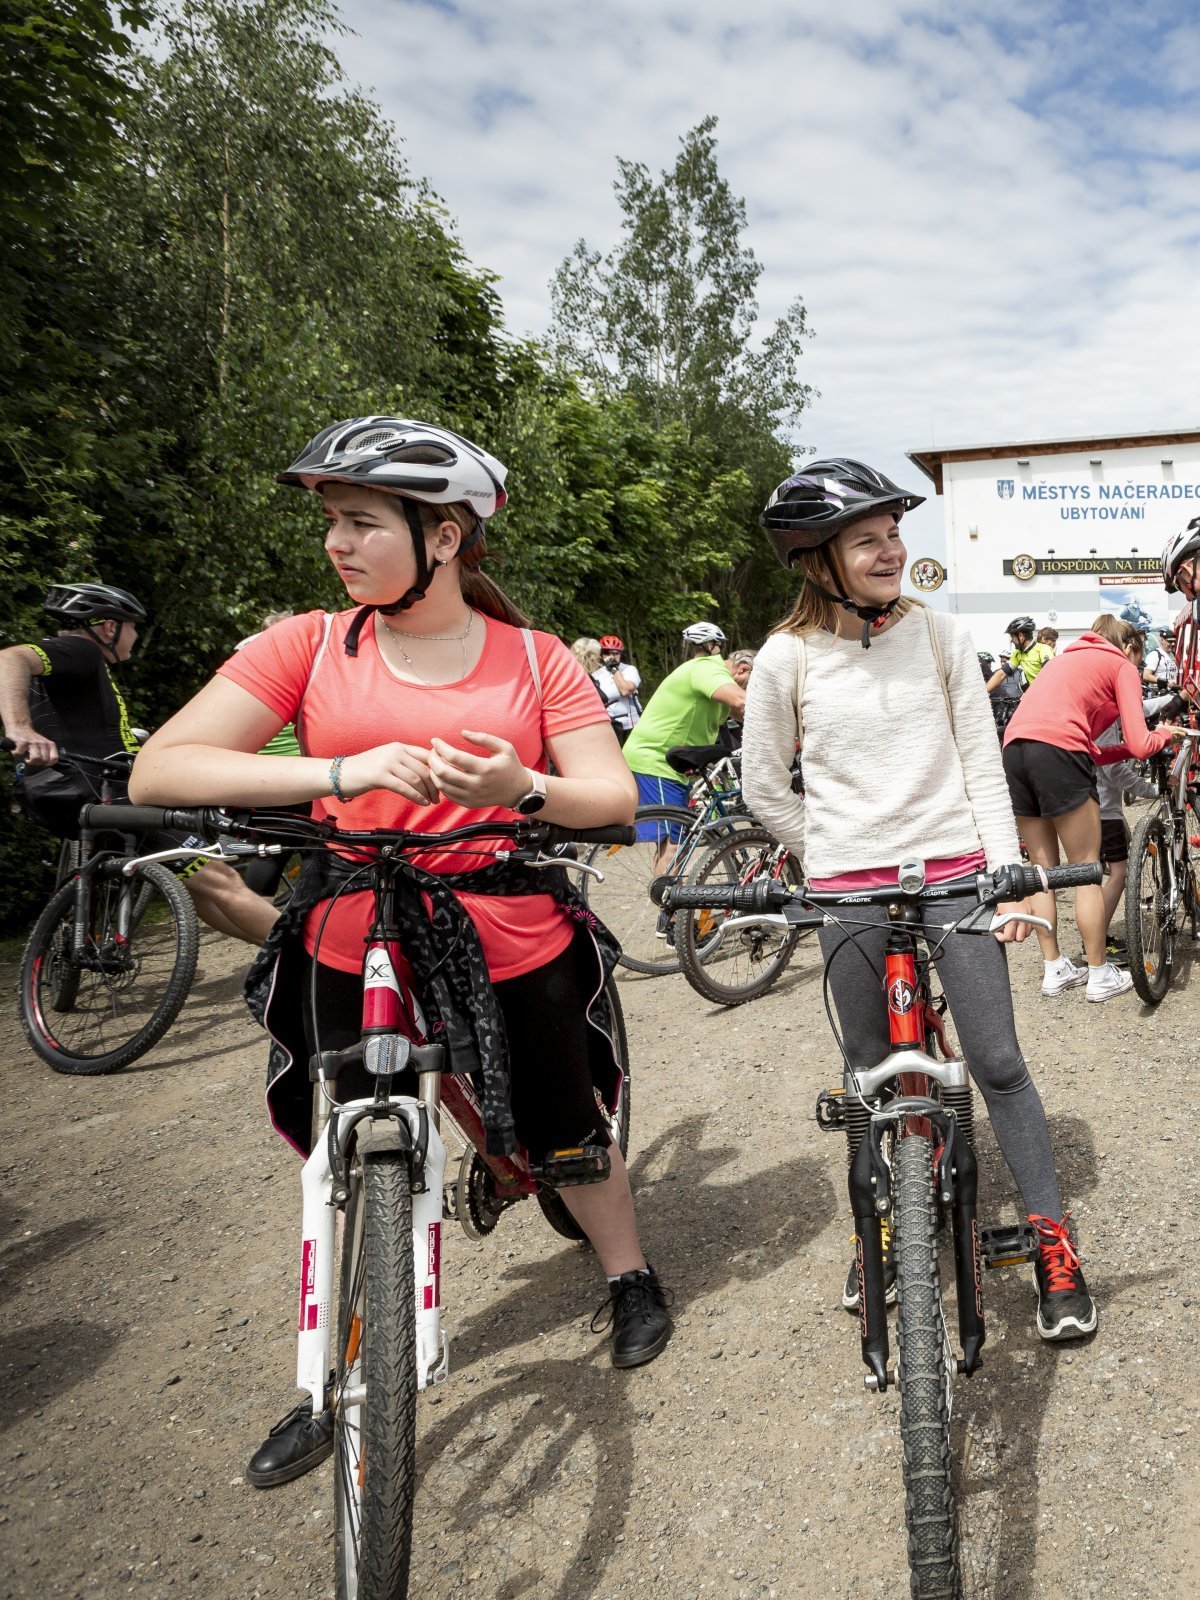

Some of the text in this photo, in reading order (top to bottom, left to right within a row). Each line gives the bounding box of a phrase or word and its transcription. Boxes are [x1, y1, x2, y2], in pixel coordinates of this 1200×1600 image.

[1022, 480, 1091, 500] MĚSTYS
[1060, 502, 1147, 520] UBYTOVÁNÍ
[1041, 559, 1110, 572] HOSPŮDKA
[1114, 560, 1133, 571] NA
